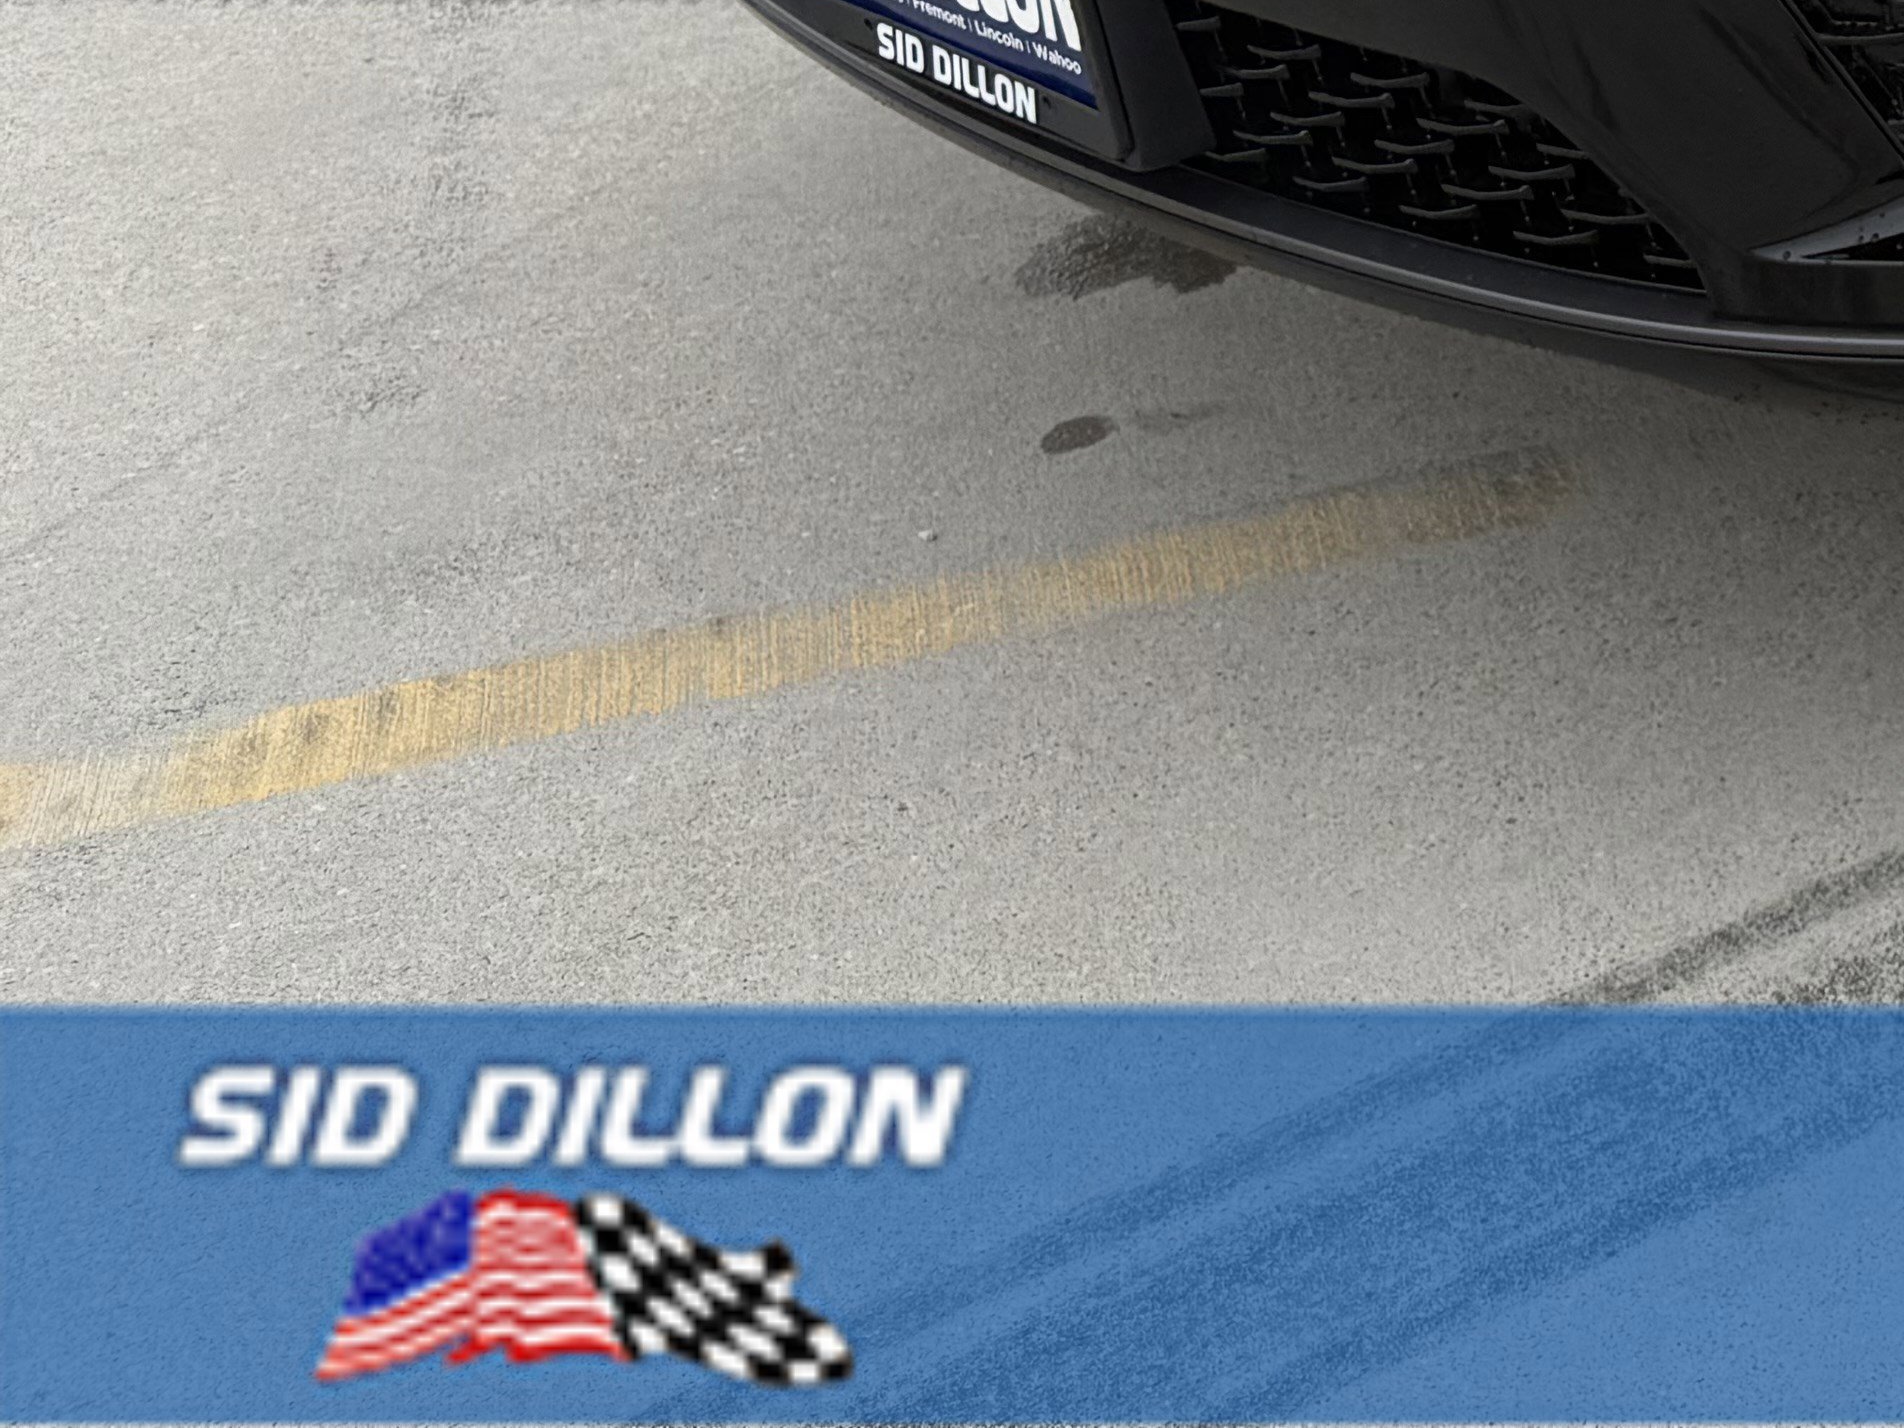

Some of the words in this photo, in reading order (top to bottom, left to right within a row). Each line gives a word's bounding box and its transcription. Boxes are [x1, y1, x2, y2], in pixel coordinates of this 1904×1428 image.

[876, 22, 925, 74] SID
[933, 49, 1038, 124] DILLON
[974, 19, 1024, 52] Lincoln
[1031, 41, 1082, 75] Wahoo
